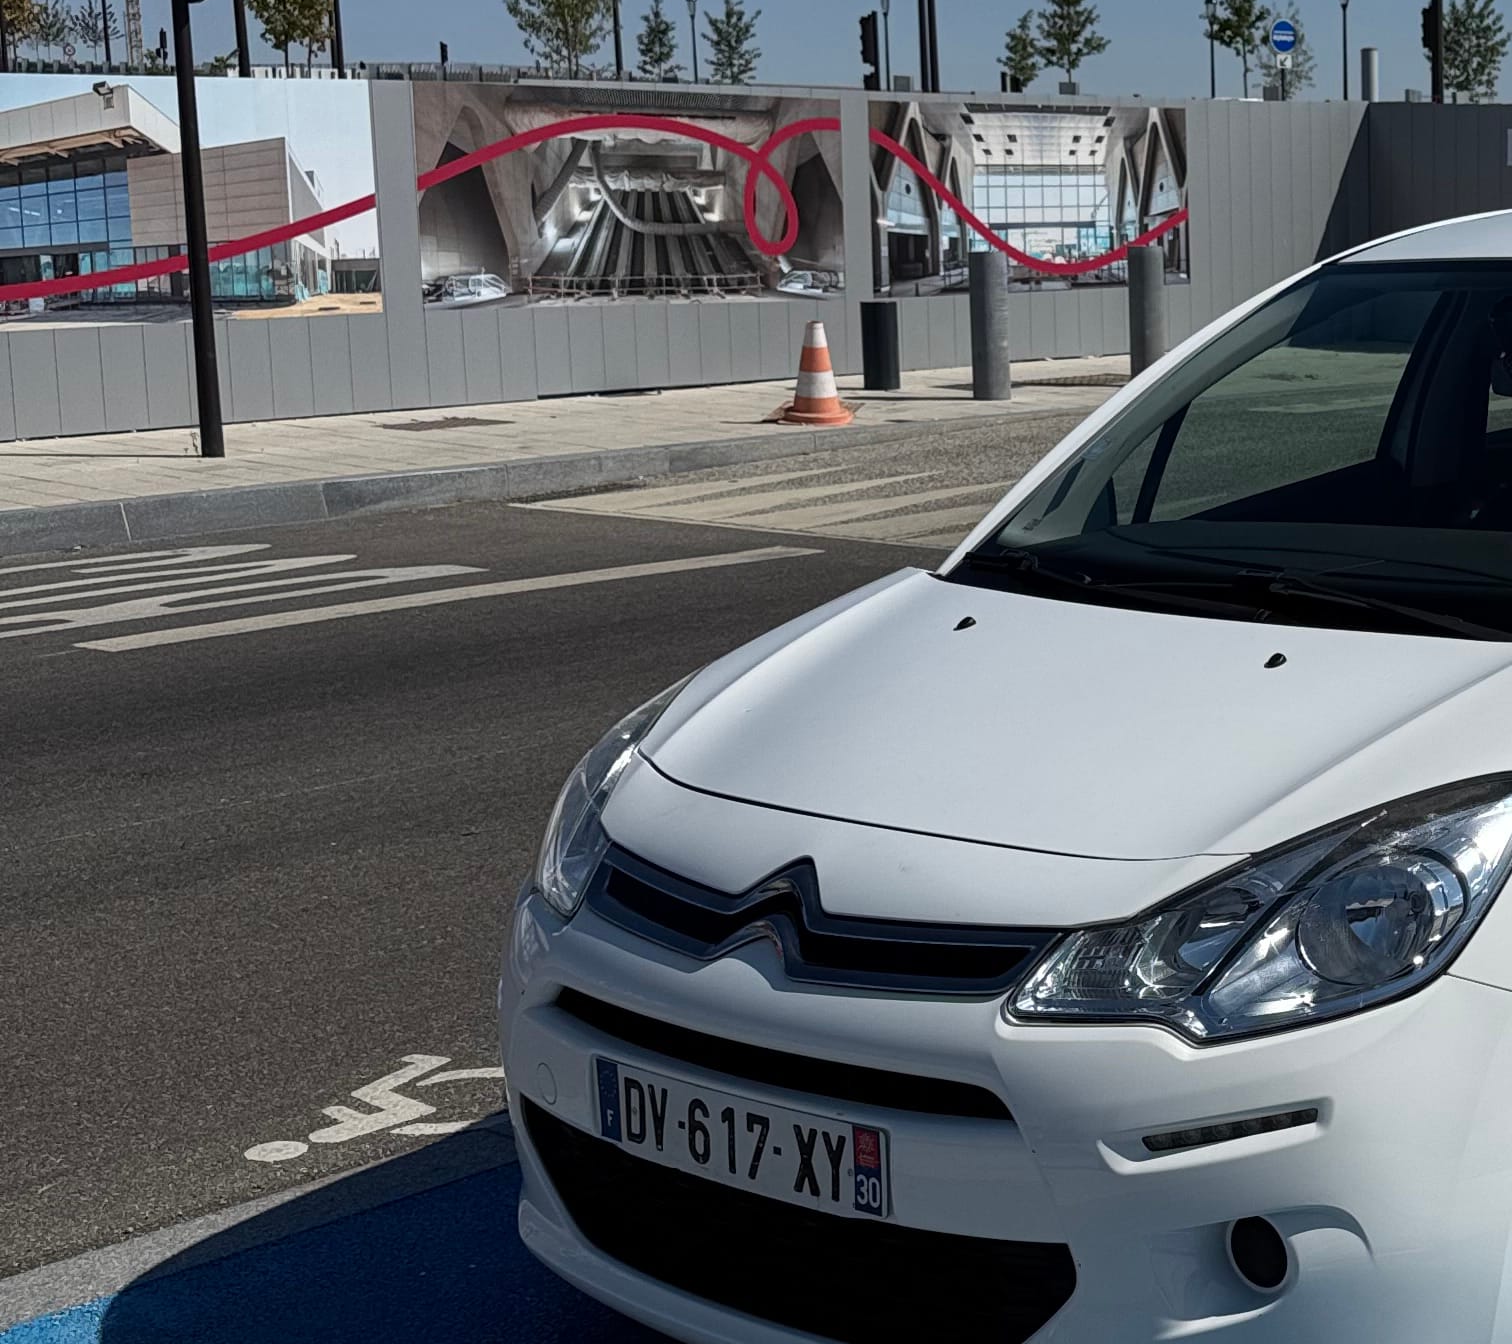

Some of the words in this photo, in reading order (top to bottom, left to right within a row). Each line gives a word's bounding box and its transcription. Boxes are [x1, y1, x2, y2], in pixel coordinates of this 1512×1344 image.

[606, 1109, 615, 1127] F
[624, 1077, 847, 1202] DV-617-XY
[856, 1174, 880, 1208] 30
